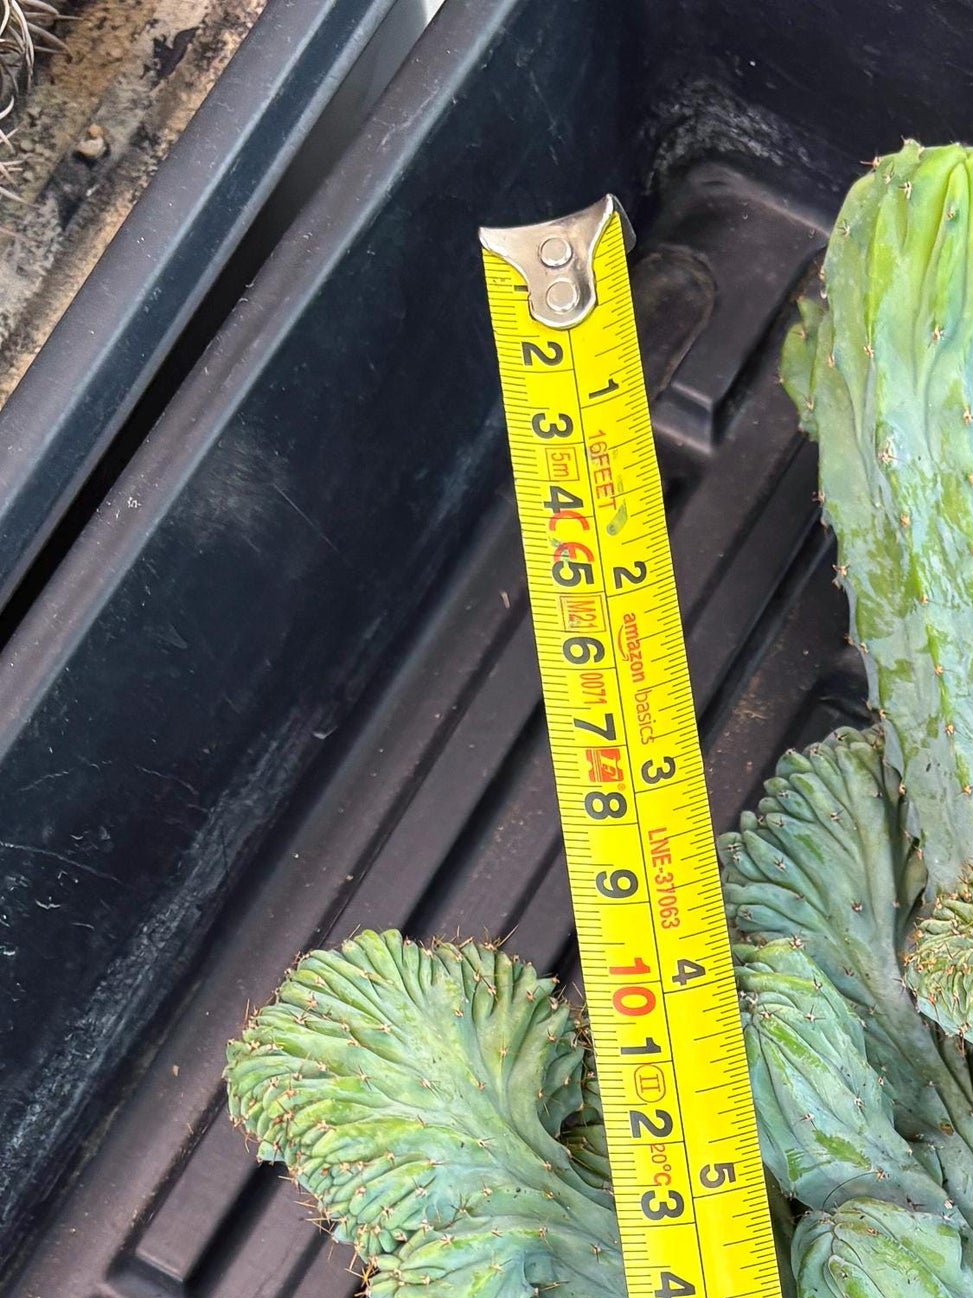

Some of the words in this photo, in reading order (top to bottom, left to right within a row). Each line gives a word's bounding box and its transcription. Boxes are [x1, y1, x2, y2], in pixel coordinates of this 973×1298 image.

[522, 341, 563, 366] 2
[588, 378, 619, 399] 1
[531, 413, 574, 440] 3
[551, 452, 571, 477] 5m
[544, 485, 584, 513] 4
[551, 561, 595, 588] 5
[612, 560, 647, 590] 2
[562, 636, 605, 665] 6
[579, 672, 607, 705] 0071
[621, 612, 646, 683] amazon
[634, 689, 655, 745] basics
[573, 712, 616, 741] 7
[641, 756, 676, 785] 3
[584, 791, 628, 820] 8
[595, 868, 639, 899] 9
[648, 827, 680, 930] LNE-37063
[608, 956, 657, 1017] 10
[671, 958, 706, 986] 4
[620, 1037, 662, 1055] 1
[628, 1109, 674, 1139] 2
[699, 1162, 737, 1189] 5
[640, 1189, 685, 1221] 3
